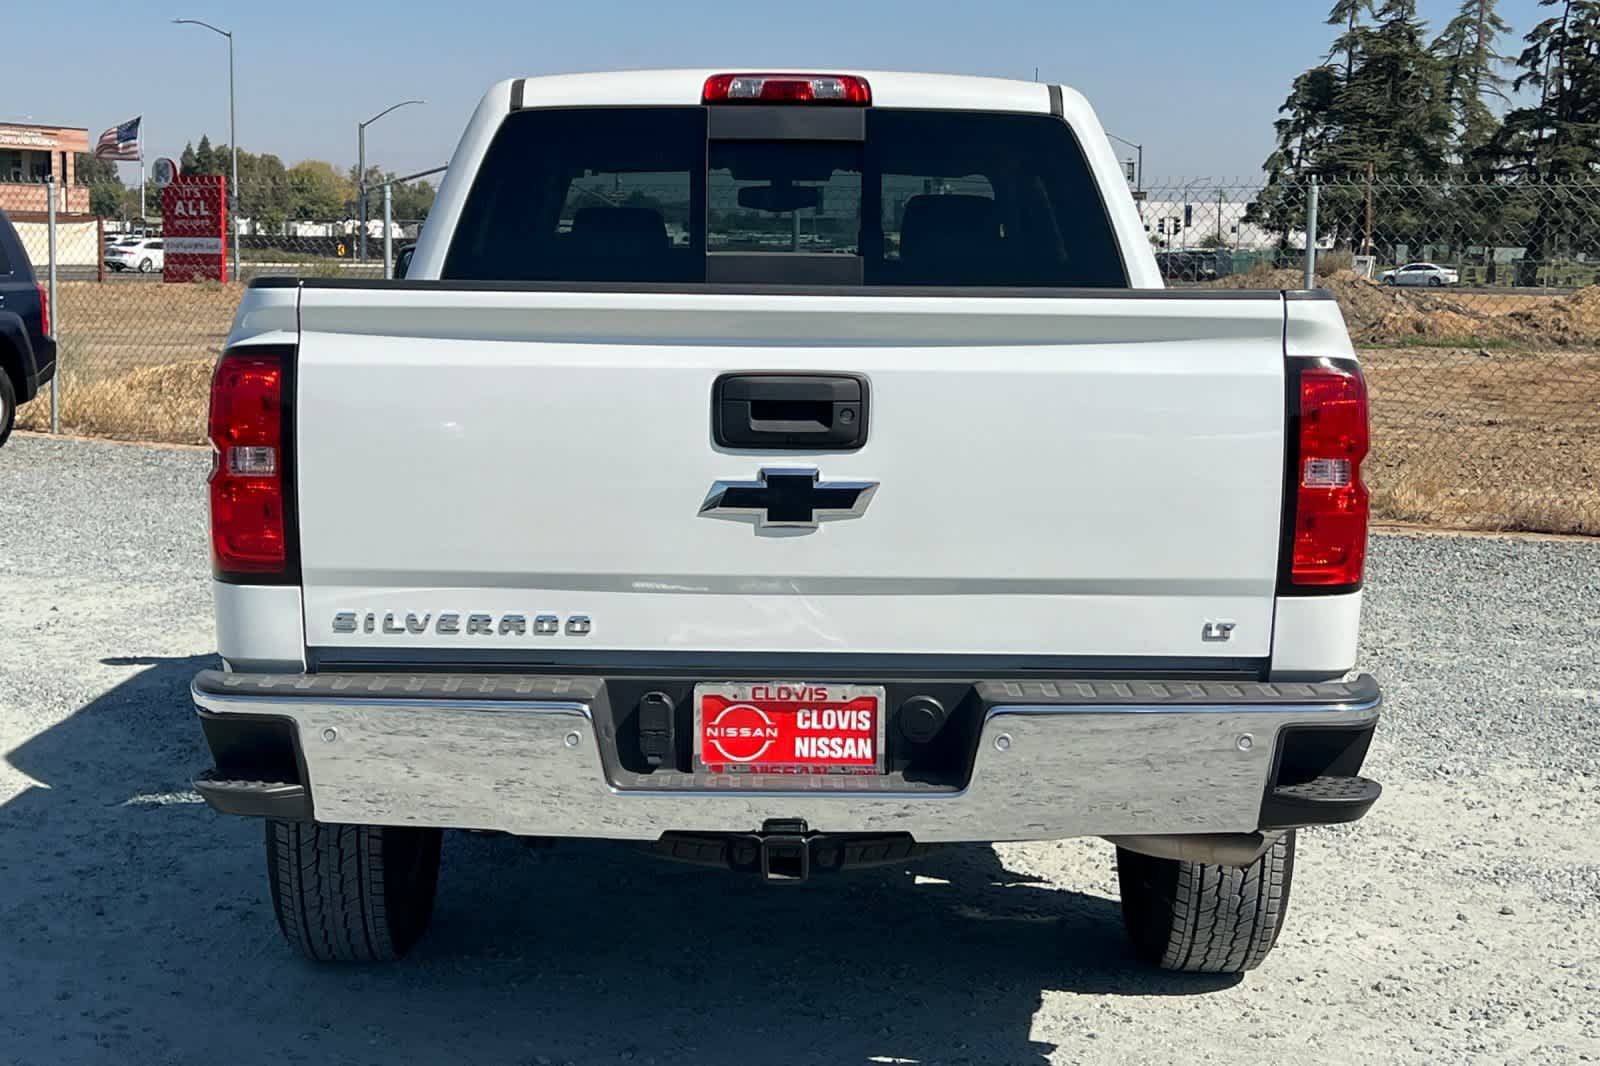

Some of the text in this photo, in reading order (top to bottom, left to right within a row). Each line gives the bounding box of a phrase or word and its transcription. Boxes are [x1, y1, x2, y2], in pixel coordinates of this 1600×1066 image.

[175, 200, 209, 216] ALL
[331, 612, 592, 636] SILVERADO
[1201, 622, 1236, 642] LT
[752, 686, 828, 701] CLOVIS
[797, 709, 871, 731] CLOVIS
[706, 727, 778, 737] NISSAN
[795, 737, 872, 759] NISSAN
